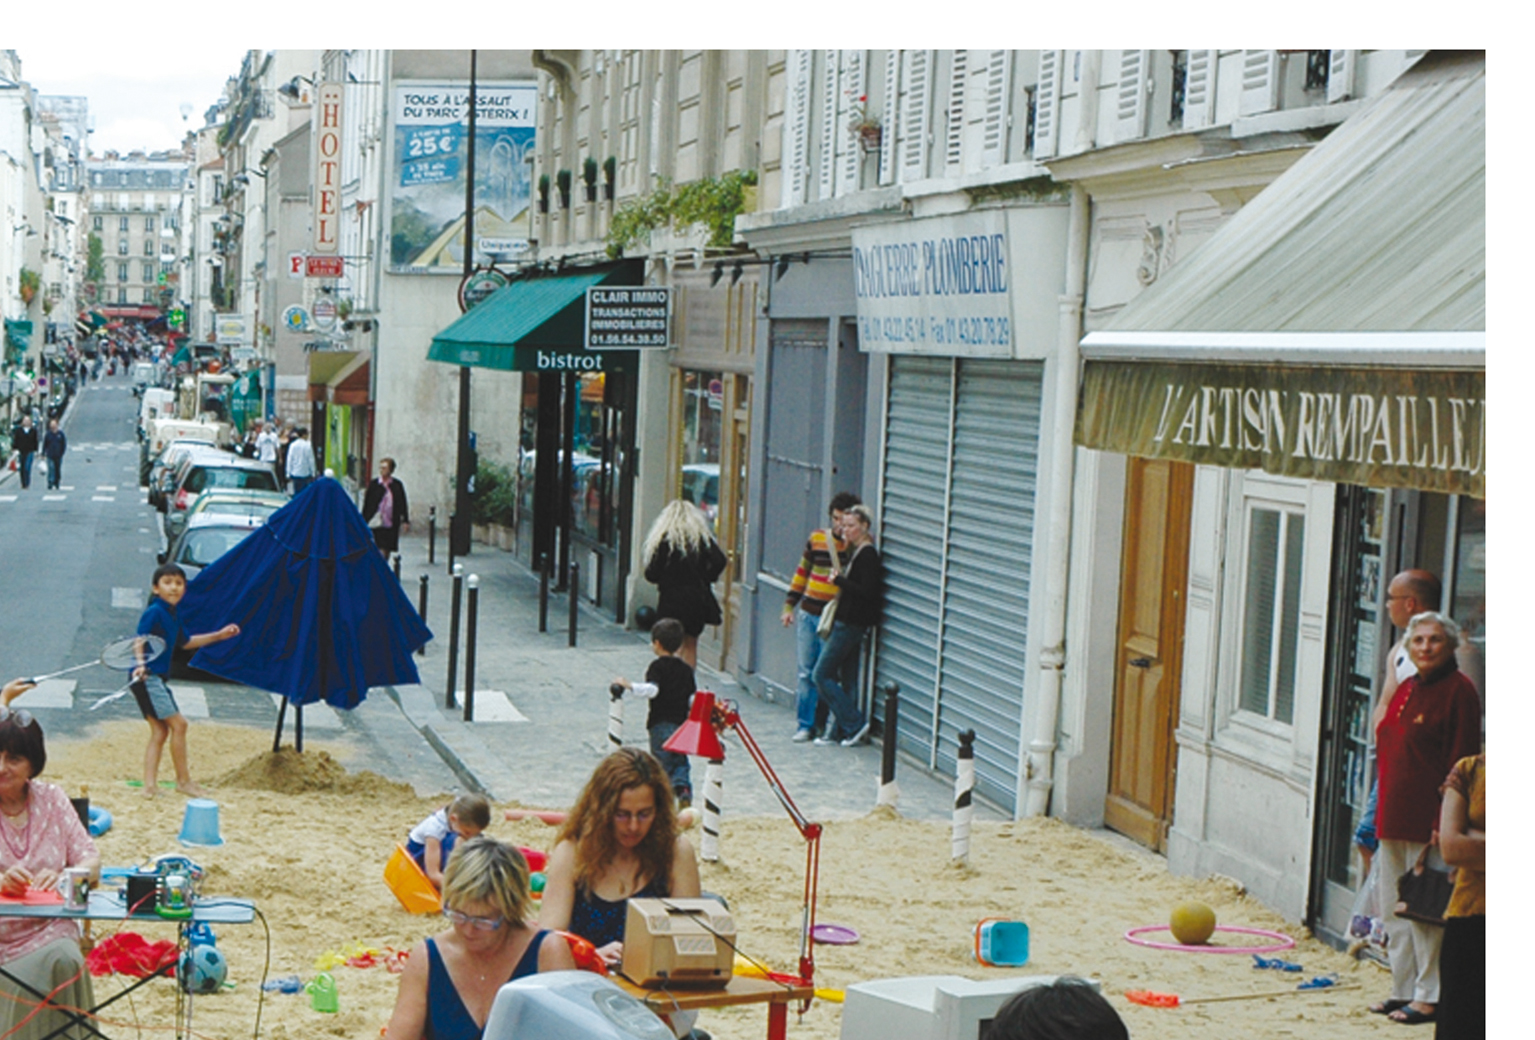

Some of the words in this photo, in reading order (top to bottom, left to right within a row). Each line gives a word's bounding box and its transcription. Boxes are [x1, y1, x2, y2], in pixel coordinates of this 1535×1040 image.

[404, 95, 438, 105] TOUS
[404, 107, 422, 118] DU
[426, 107, 459, 118] PARC
[318, 103, 339, 244] HOTEL
[854, 242, 921, 298] DAGUERRE
[922, 233, 1007, 296] PLOMBERIE
[592, 291, 630, 304] CLAIR
[632, 291, 667, 304] IMMO
[592, 307, 666, 318] TRANSACTIONS
[537, 350, 603, 370] bistrot
[1292, 390, 1485, 476] REMPAILLEU
